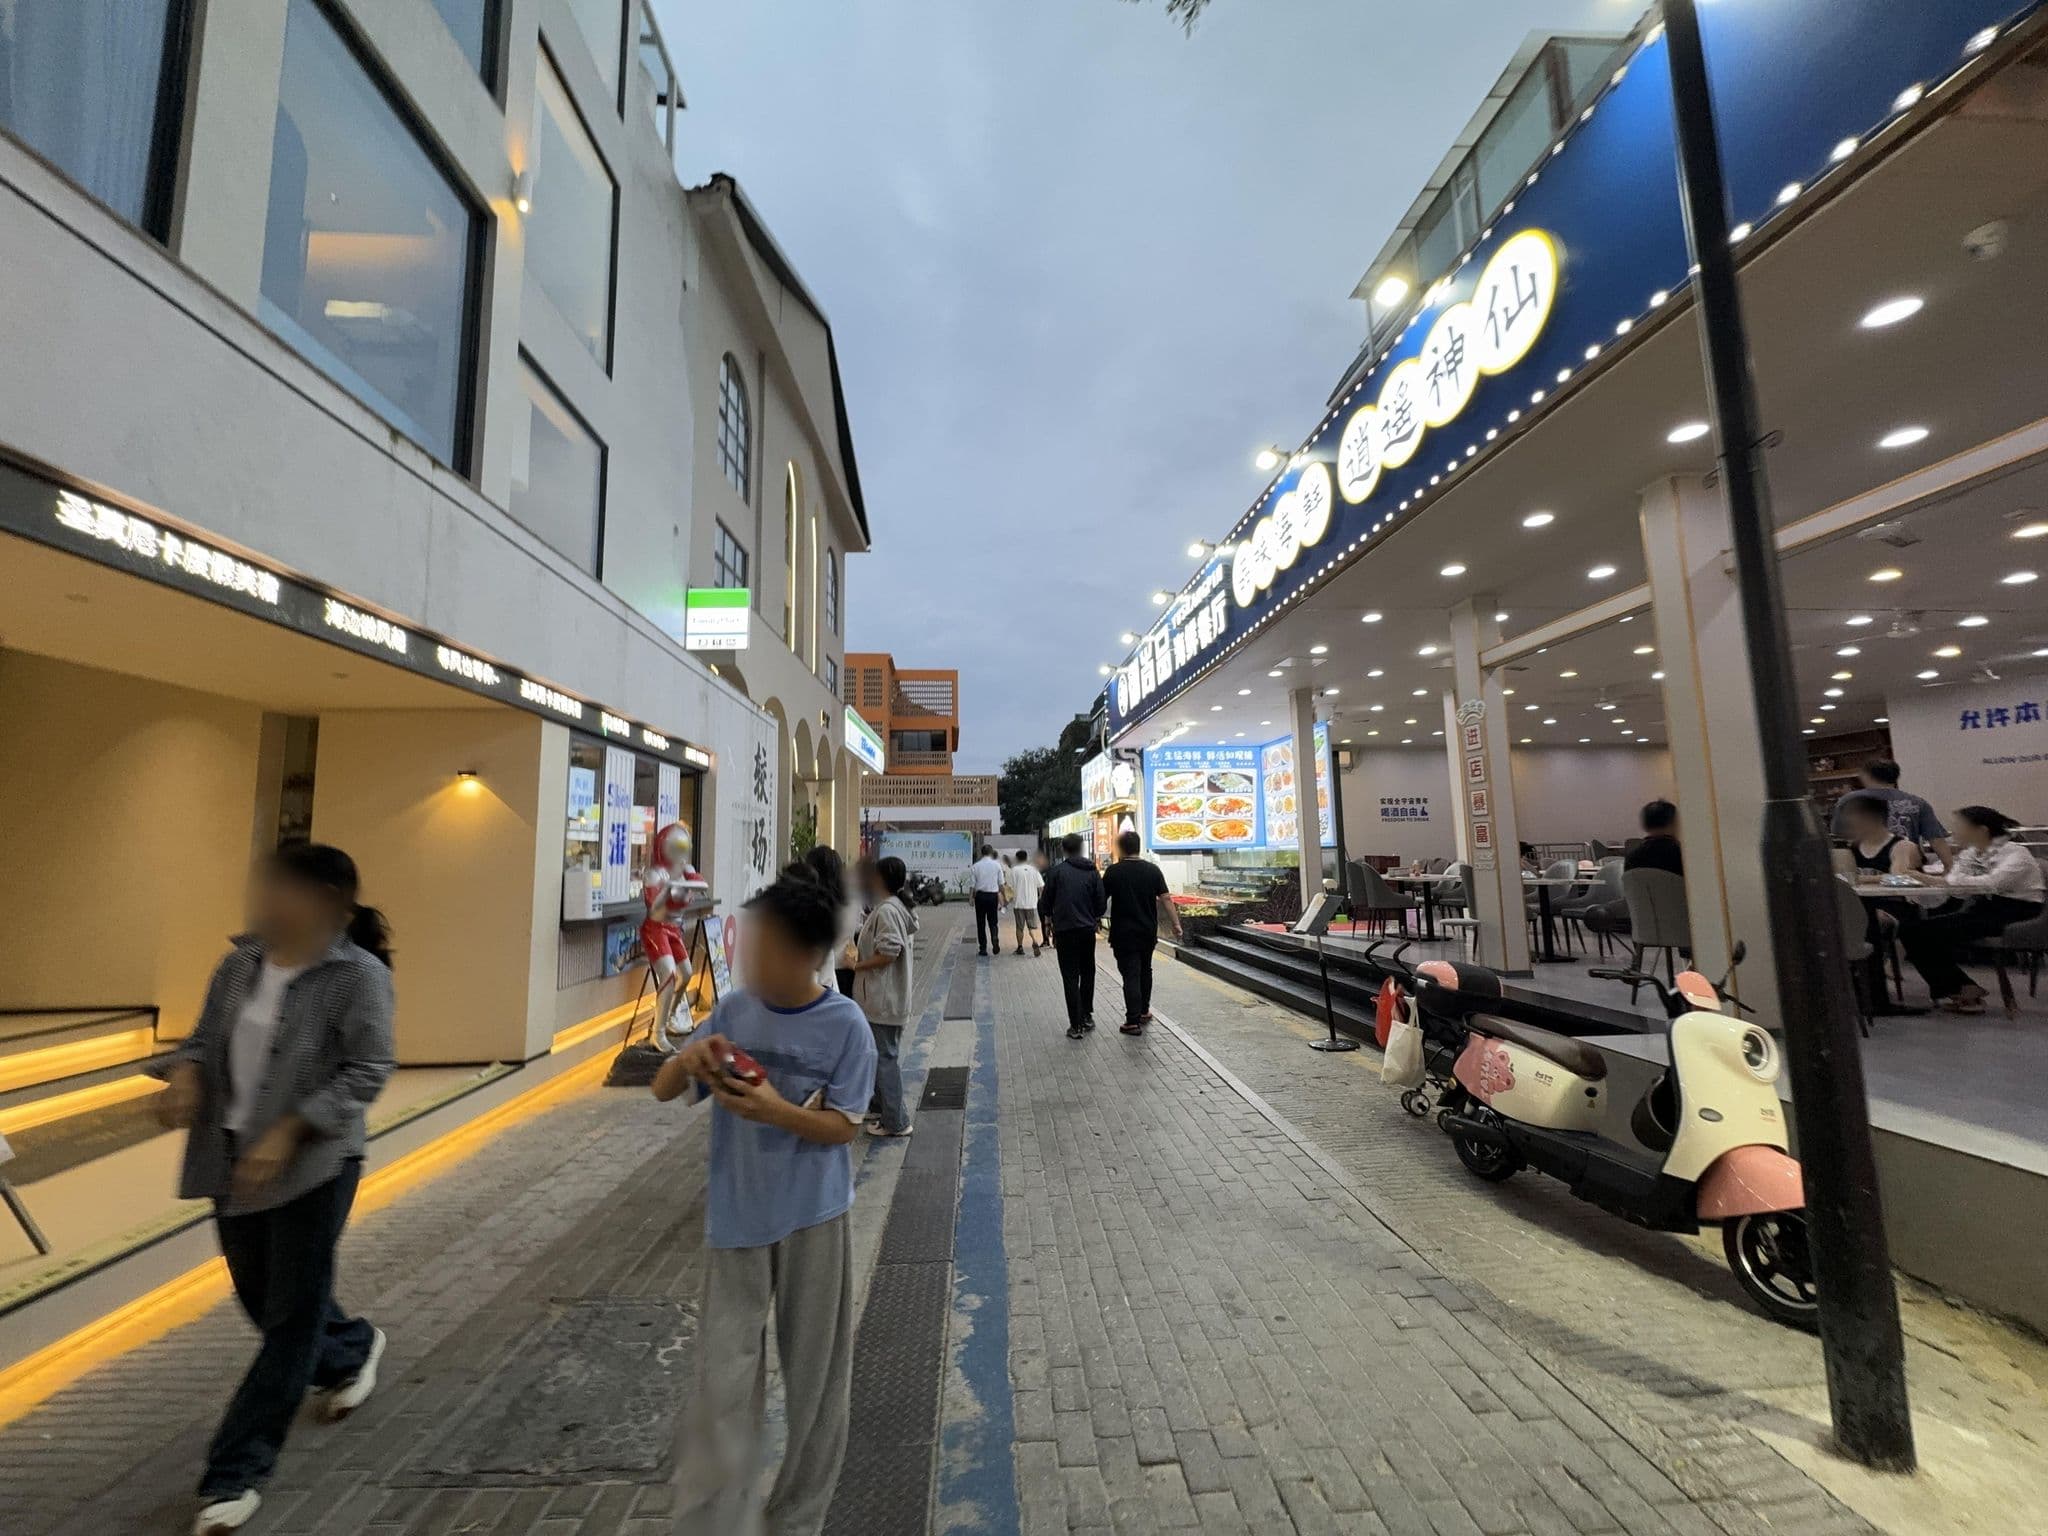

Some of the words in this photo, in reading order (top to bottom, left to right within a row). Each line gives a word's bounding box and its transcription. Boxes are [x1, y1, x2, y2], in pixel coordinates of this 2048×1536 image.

[1347, 265, 1538, 487] 逍遥神仙
[1960, 701, 2048, 730] 允许本
[1381, 807, 1418, 817] 喝酒自由
